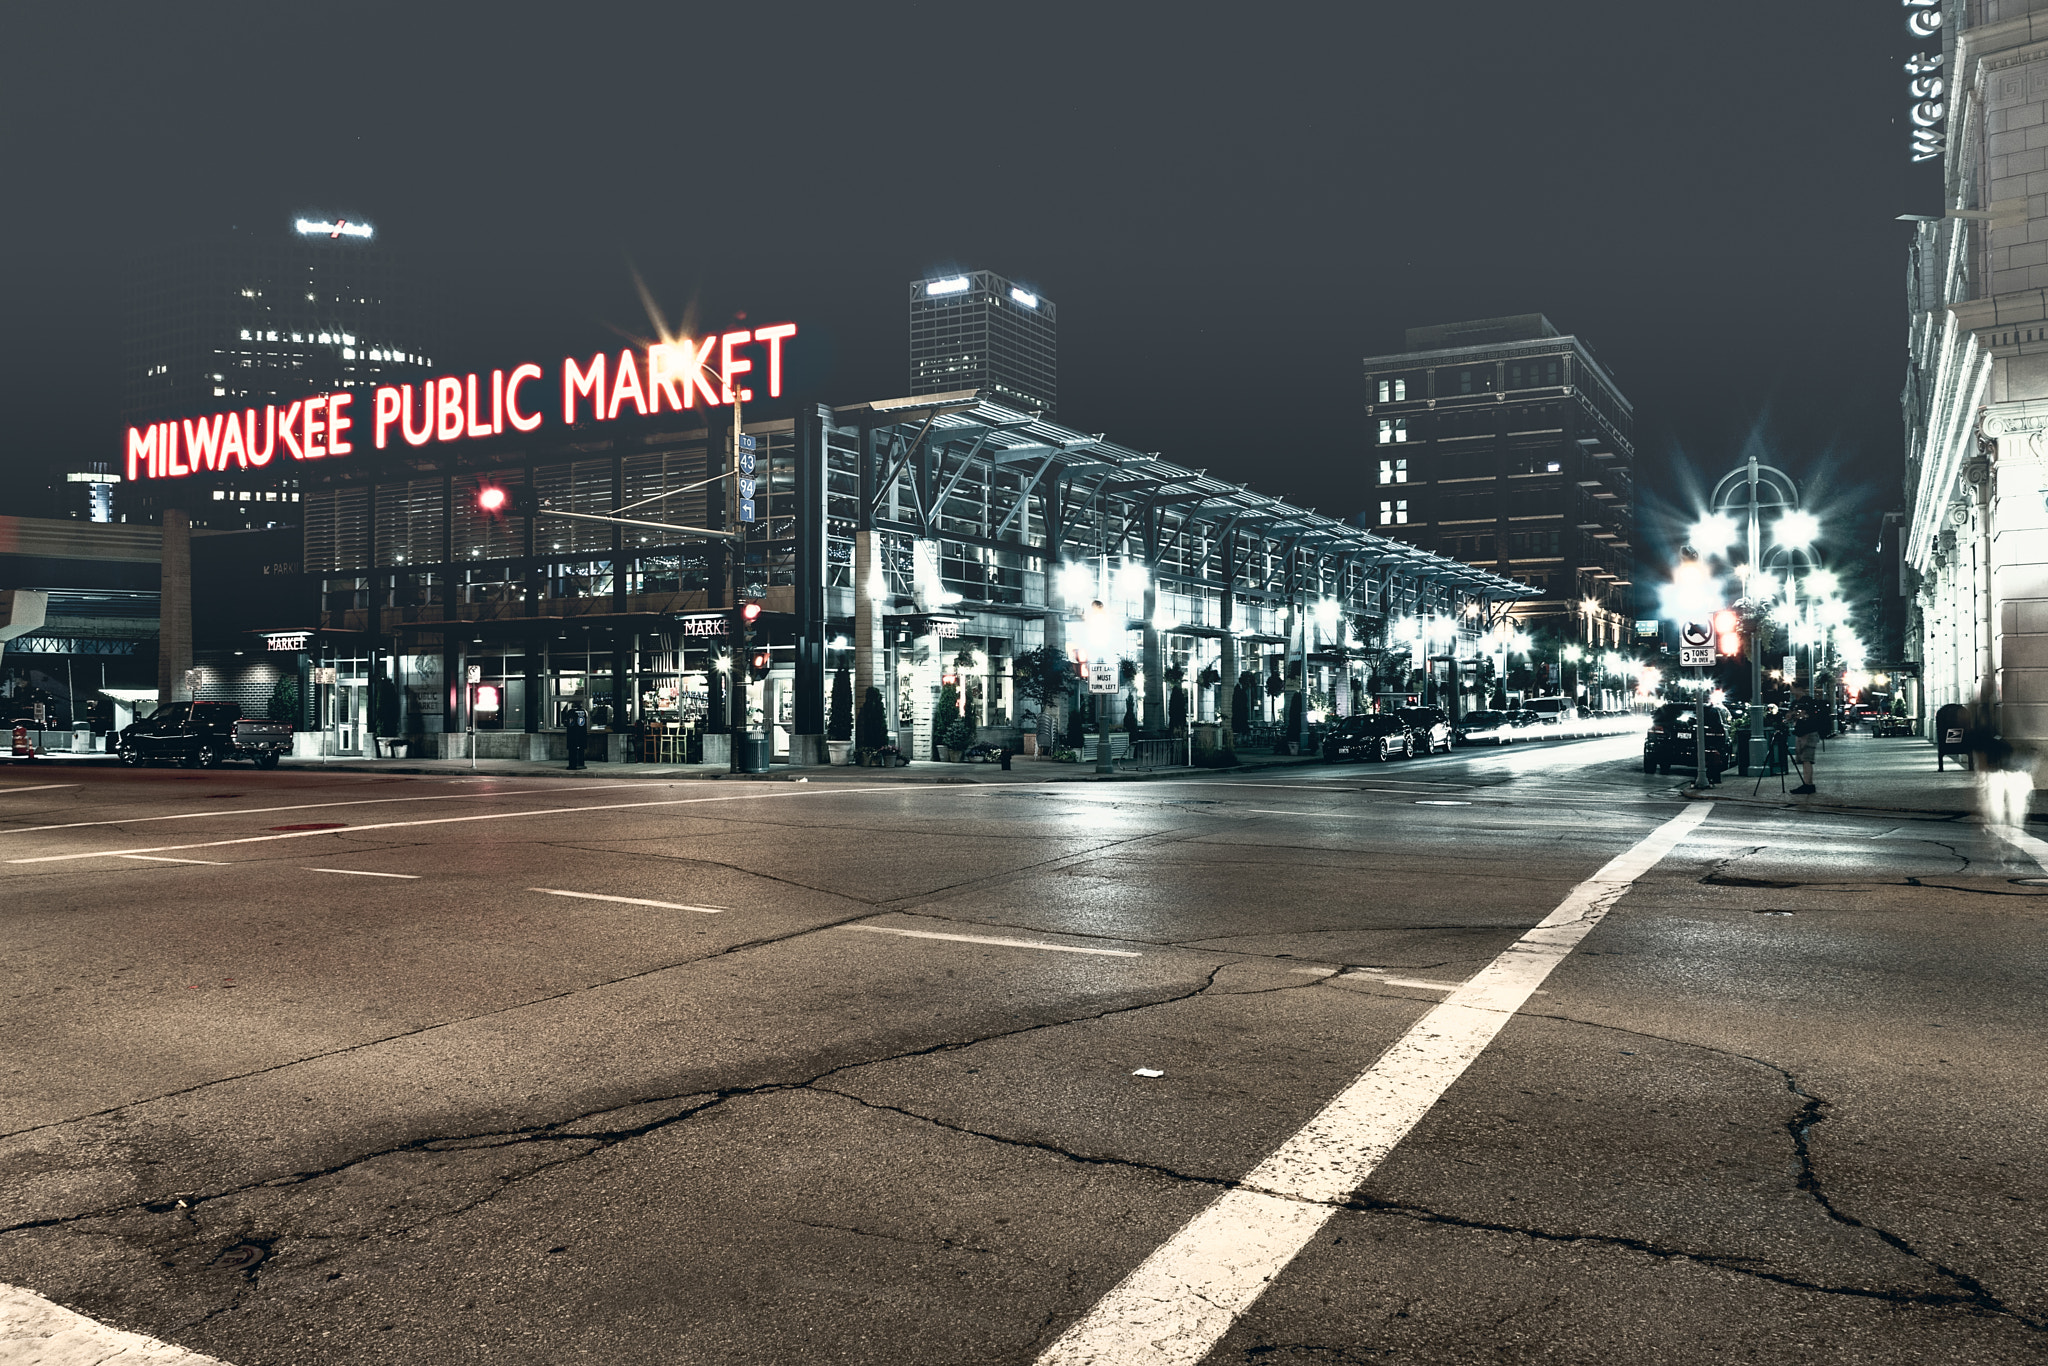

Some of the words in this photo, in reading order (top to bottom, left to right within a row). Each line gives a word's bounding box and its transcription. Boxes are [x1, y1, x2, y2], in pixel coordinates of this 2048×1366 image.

[1906, 52, 1945, 161] west
[128, 394, 352, 480] MILWAUKEE
[375, 364, 542, 449] PUBLIC
[564, 323, 796, 424] MARKET
[742, 437, 752, 447] TO
[740, 454, 754, 470] 43
[740, 479, 753, 495] 94
[267, 636, 306, 651] MARKET
[1683, 652, 1690, 662] 3
